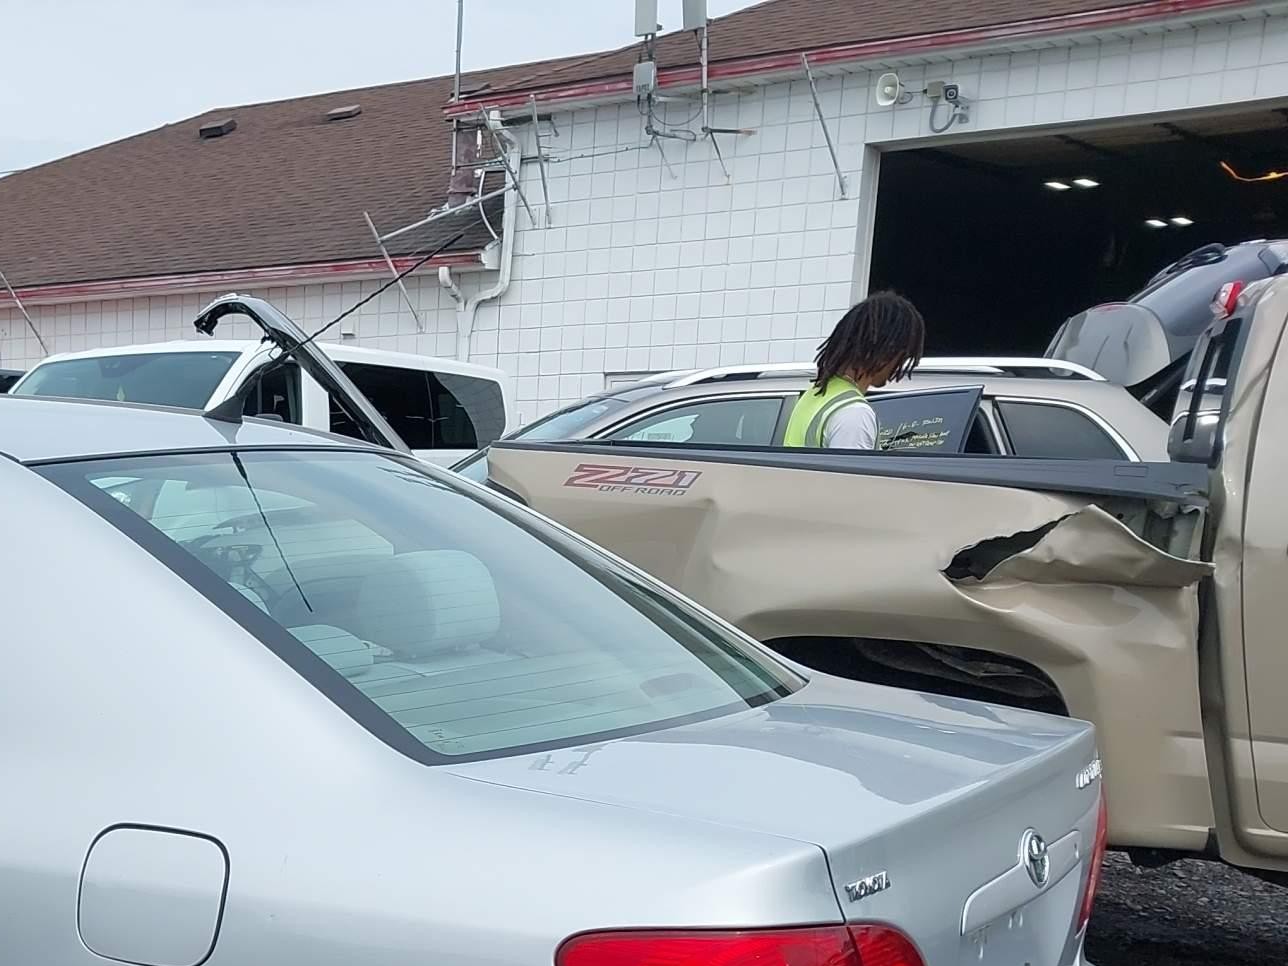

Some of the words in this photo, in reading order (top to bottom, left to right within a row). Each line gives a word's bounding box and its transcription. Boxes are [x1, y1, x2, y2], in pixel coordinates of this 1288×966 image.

[563, 463, 703, 489] Z71
[598, 485, 633, 493] OFF
[634, 487, 687, 497] ROAD
